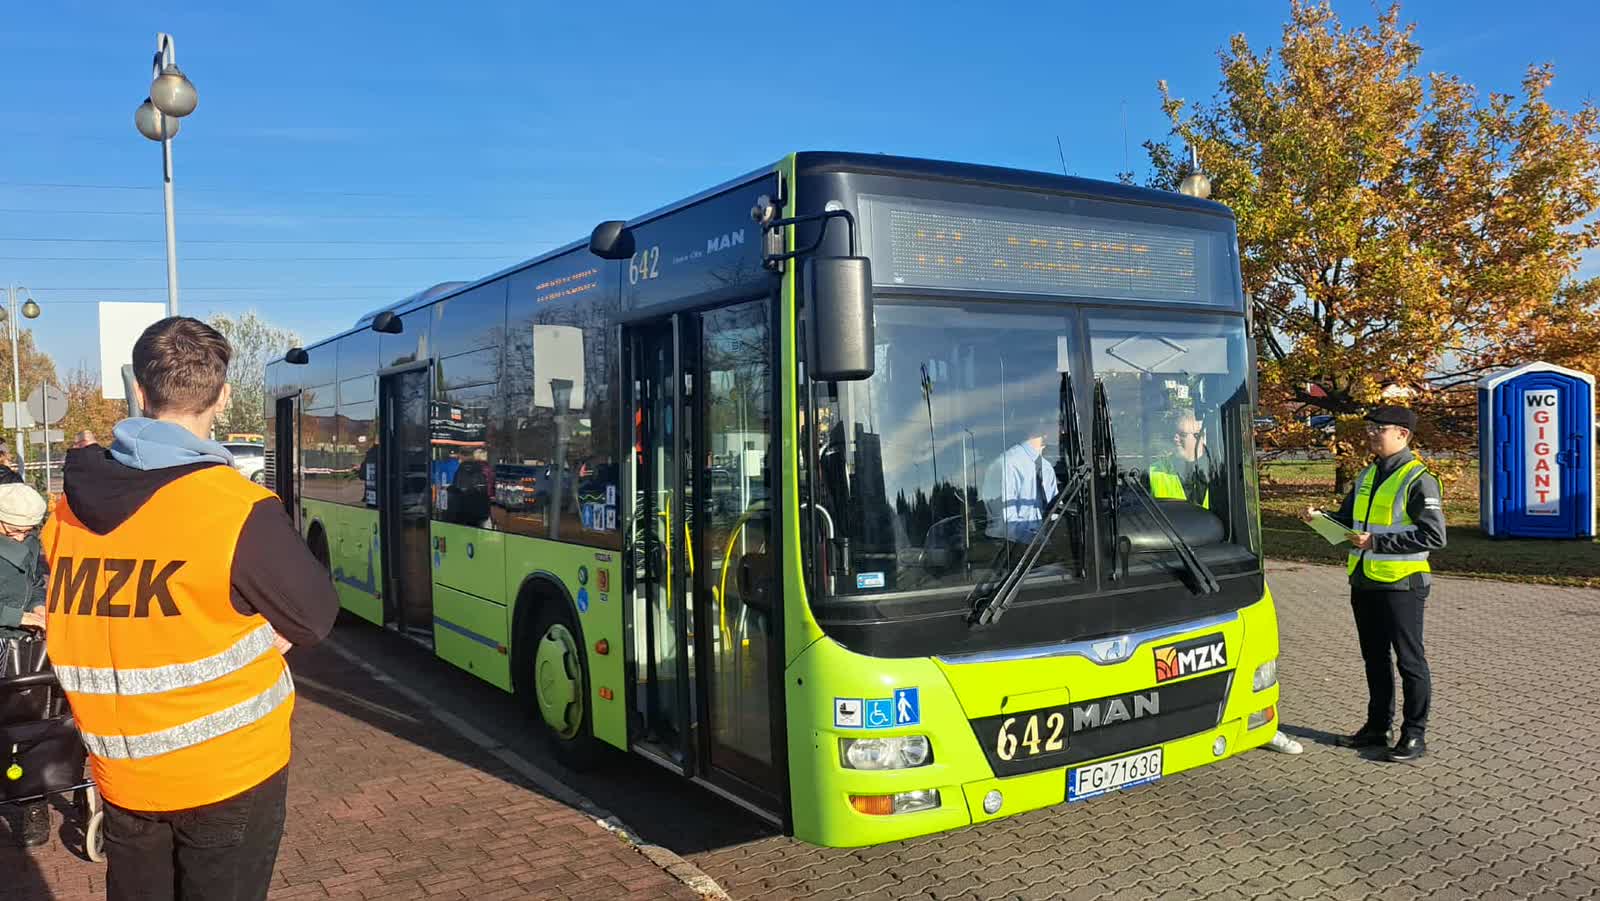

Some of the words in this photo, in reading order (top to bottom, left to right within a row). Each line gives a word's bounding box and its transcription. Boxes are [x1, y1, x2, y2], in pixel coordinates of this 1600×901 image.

[707, 229, 744, 254] MAN
[629, 246, 659, 285] 642
[1526, 394, 1556, 407] WC
[1534, 410, 1550, 504] GIGANT
[48, 556, 187, 618] MZK
[1178, 641, 1226, 675] MZK
[1072, 691, 1160, 732] MAN
[997, 712, 1065, 761] 642
[1079, 767, 1104, 793] FG
[1109, 753, 1158, 785] 7163G
